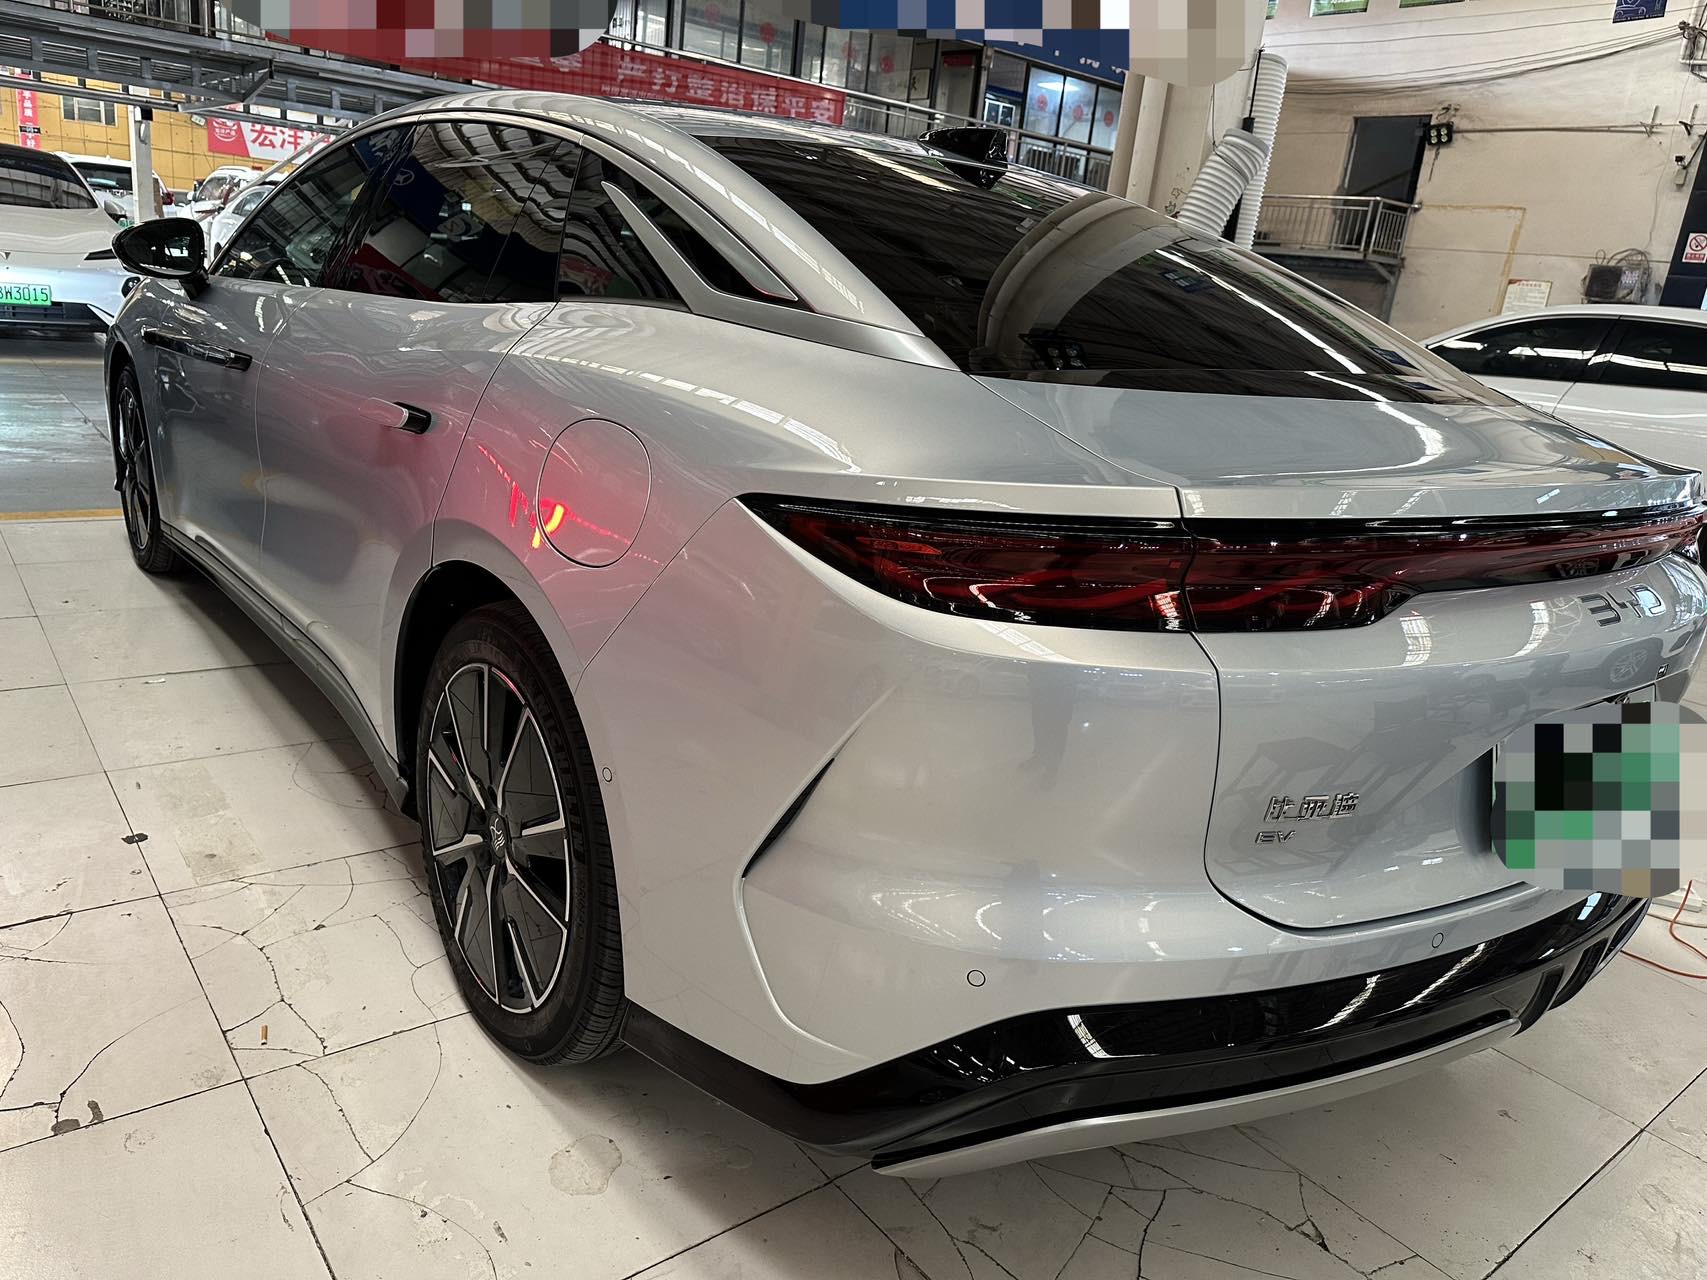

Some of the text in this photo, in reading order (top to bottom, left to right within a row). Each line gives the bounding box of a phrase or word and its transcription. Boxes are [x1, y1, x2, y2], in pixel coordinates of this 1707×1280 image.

[616, 54, 836, 124] 严打整治保平安
[1577, 583, 1667, 628] BYD
[1263, 791, 1360, 822] 比亚迪
[1254, 830, 1298, 844] EV
